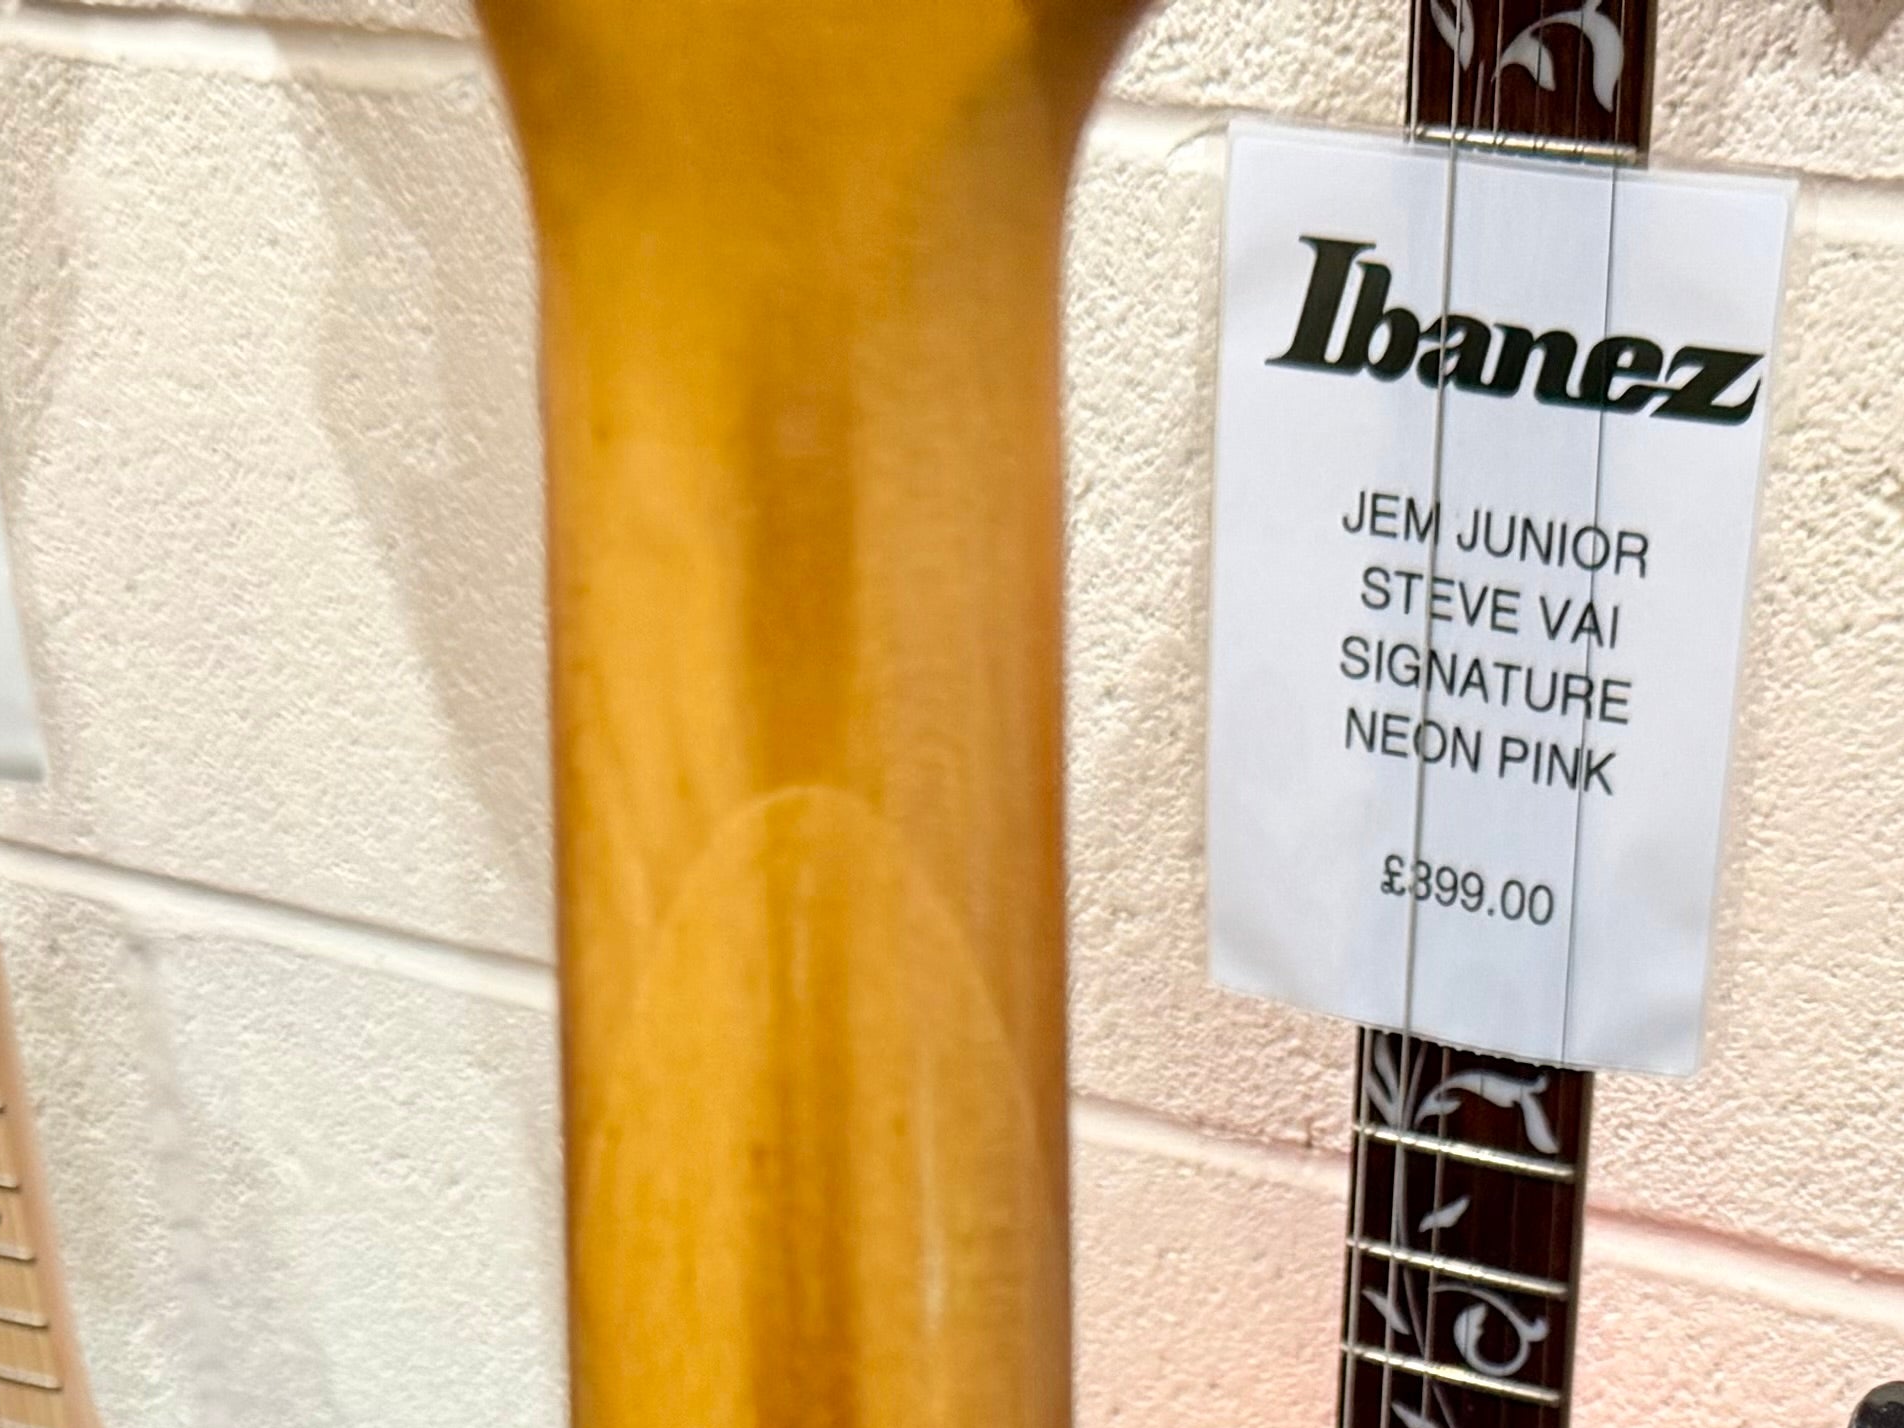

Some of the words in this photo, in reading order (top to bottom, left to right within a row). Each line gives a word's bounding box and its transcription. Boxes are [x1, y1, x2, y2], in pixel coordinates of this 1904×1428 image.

[1264, 235, 1766, 427] Ibanez
[1342, 490, 1441, 545] JEM
[1457, 506, 1650, 578] JUNIOR
[1360, 566, 1521, 634] STEVE
[1539, 595, 1620, 649] VAI
[1339, 635, 1633, 725] SIGNATURE
[1345, 706, 1482, 774] NEON
[1498, 735, 1617, 796] PINK
